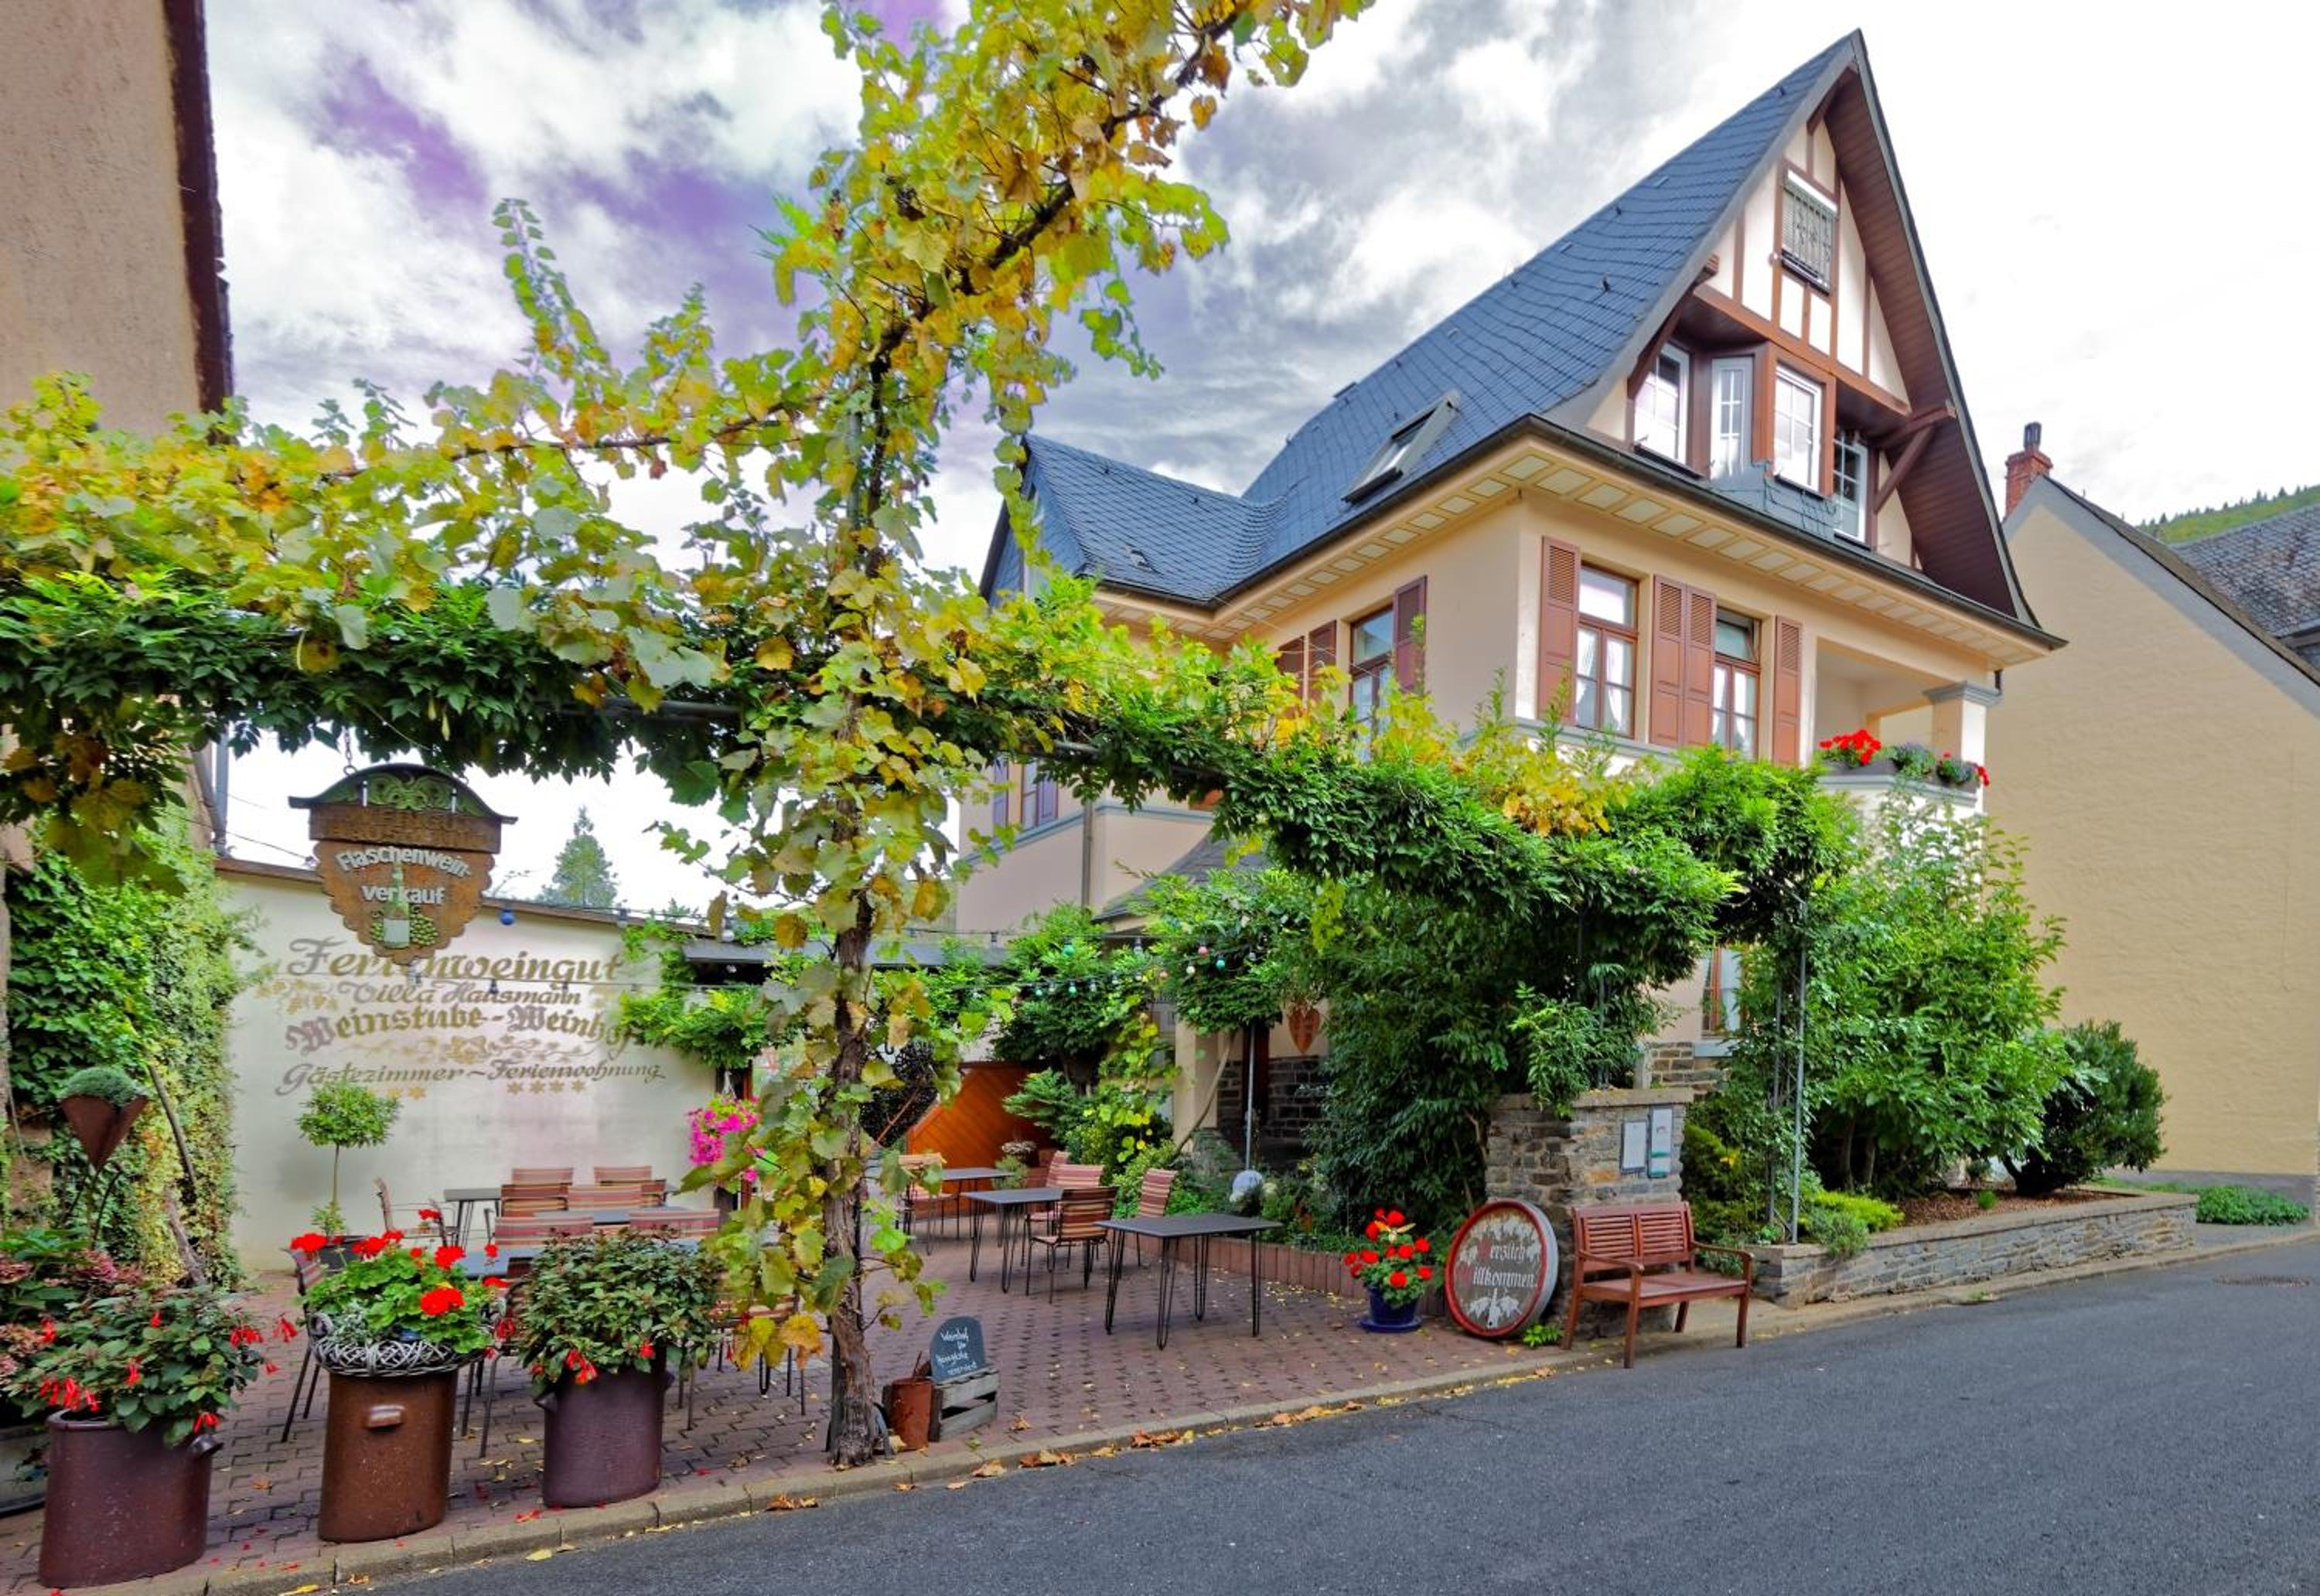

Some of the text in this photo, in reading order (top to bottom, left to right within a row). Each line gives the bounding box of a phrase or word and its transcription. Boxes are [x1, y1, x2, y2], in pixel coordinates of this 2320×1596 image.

[335, 846, 471, 878] Flaschenwein-
[360, 885, 446, 905] verkauf
[337, 980, 436, 1004] Villa
[285, 1004, 485, 1055] Weinstube
[275, 1062, 465, 1096] Gästezimmer
[487, 1059, 667, 1083] Ferienwohnung
[1478, 1237, 1526, 1264] Herzlich
